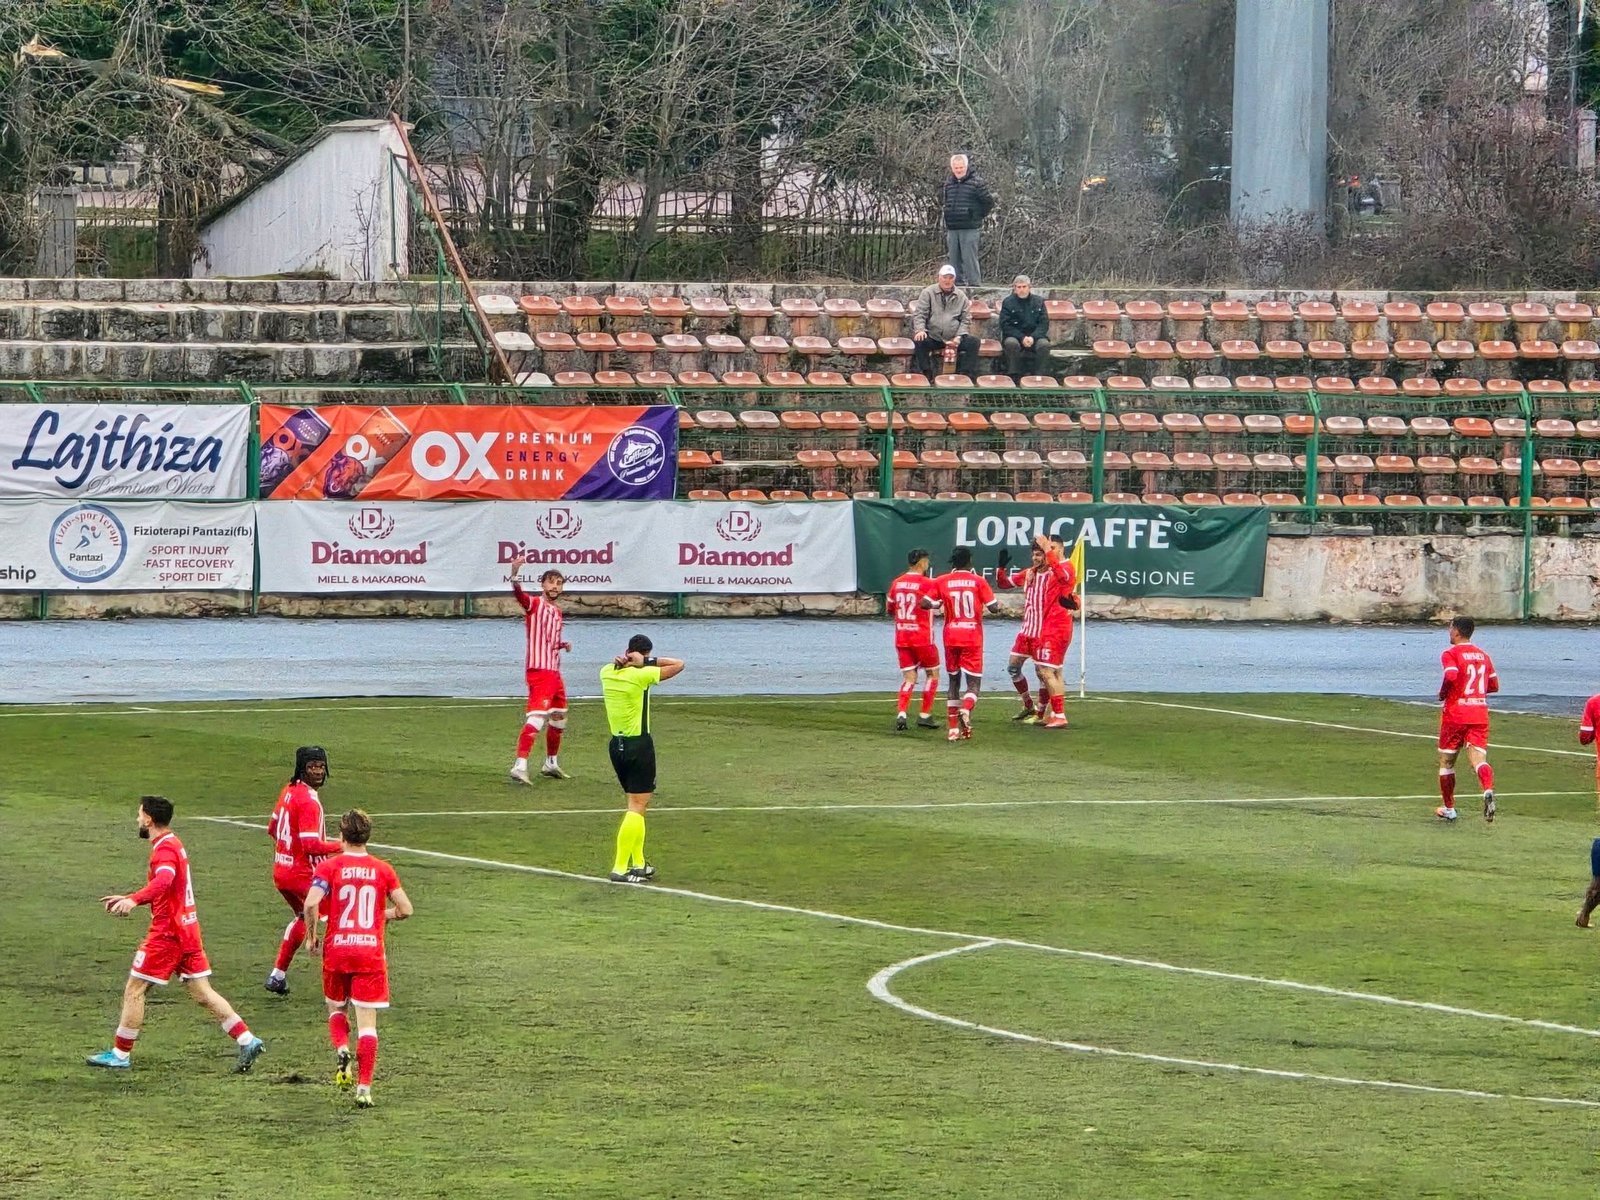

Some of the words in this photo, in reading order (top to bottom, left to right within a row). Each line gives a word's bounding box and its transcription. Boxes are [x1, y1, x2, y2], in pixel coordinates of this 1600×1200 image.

[506, 432, 592, 445] PREMIUM
[12, 409, 223, 489] Lajthiza
[411, 430, 500, 481] OX
[506, 451, 580, 463] ENERGY
[506, 469, 565, 481] DRINK
[86, 474, 160, 494] Premium
[166, 472, 216, 495] Water
[133, 526, 190, 537] Fizioterapi
[192, 527, 252, 537] Pantazi(fb)
[956, 513, 1172, 549] LORICAFFÈ
[69, 553, 103, 562] Pantazi
[148, 546, 185, 555] -SPORT
[189, 546, 229, 555] INJURY
[311, 541, 427, 565] Diamond
[497, 540, 614, 565] Diamond
[678, 542, 793, 567] Diamond
[142, 559, 171, 568] -FAST
[175, 559, 234, 569] RECOVERY
[0, 565, 37, 583] ship
[159, 573, 194, 582] SPORT
[197, 573, 222, 582] DIET
[318, 575, 349, 584] MIELL
[351, 575, 359, 584] &
[362, 575, 426, 584] MAKARONA
[503, 575, 534, 584] MELL
[684, 576, 714, 585] MIELL
[717, 576, 725, 585] &
[728, 576, 792, 585] MAKARONA
[1086, 569, 1195, 586] PASSIONE
[896, 592, 917, 620] 32
[1464, 664, 1486, 695] 21
[341, 867, 376, 880] ESTRELA
[339, 884, 376, 929] 20
